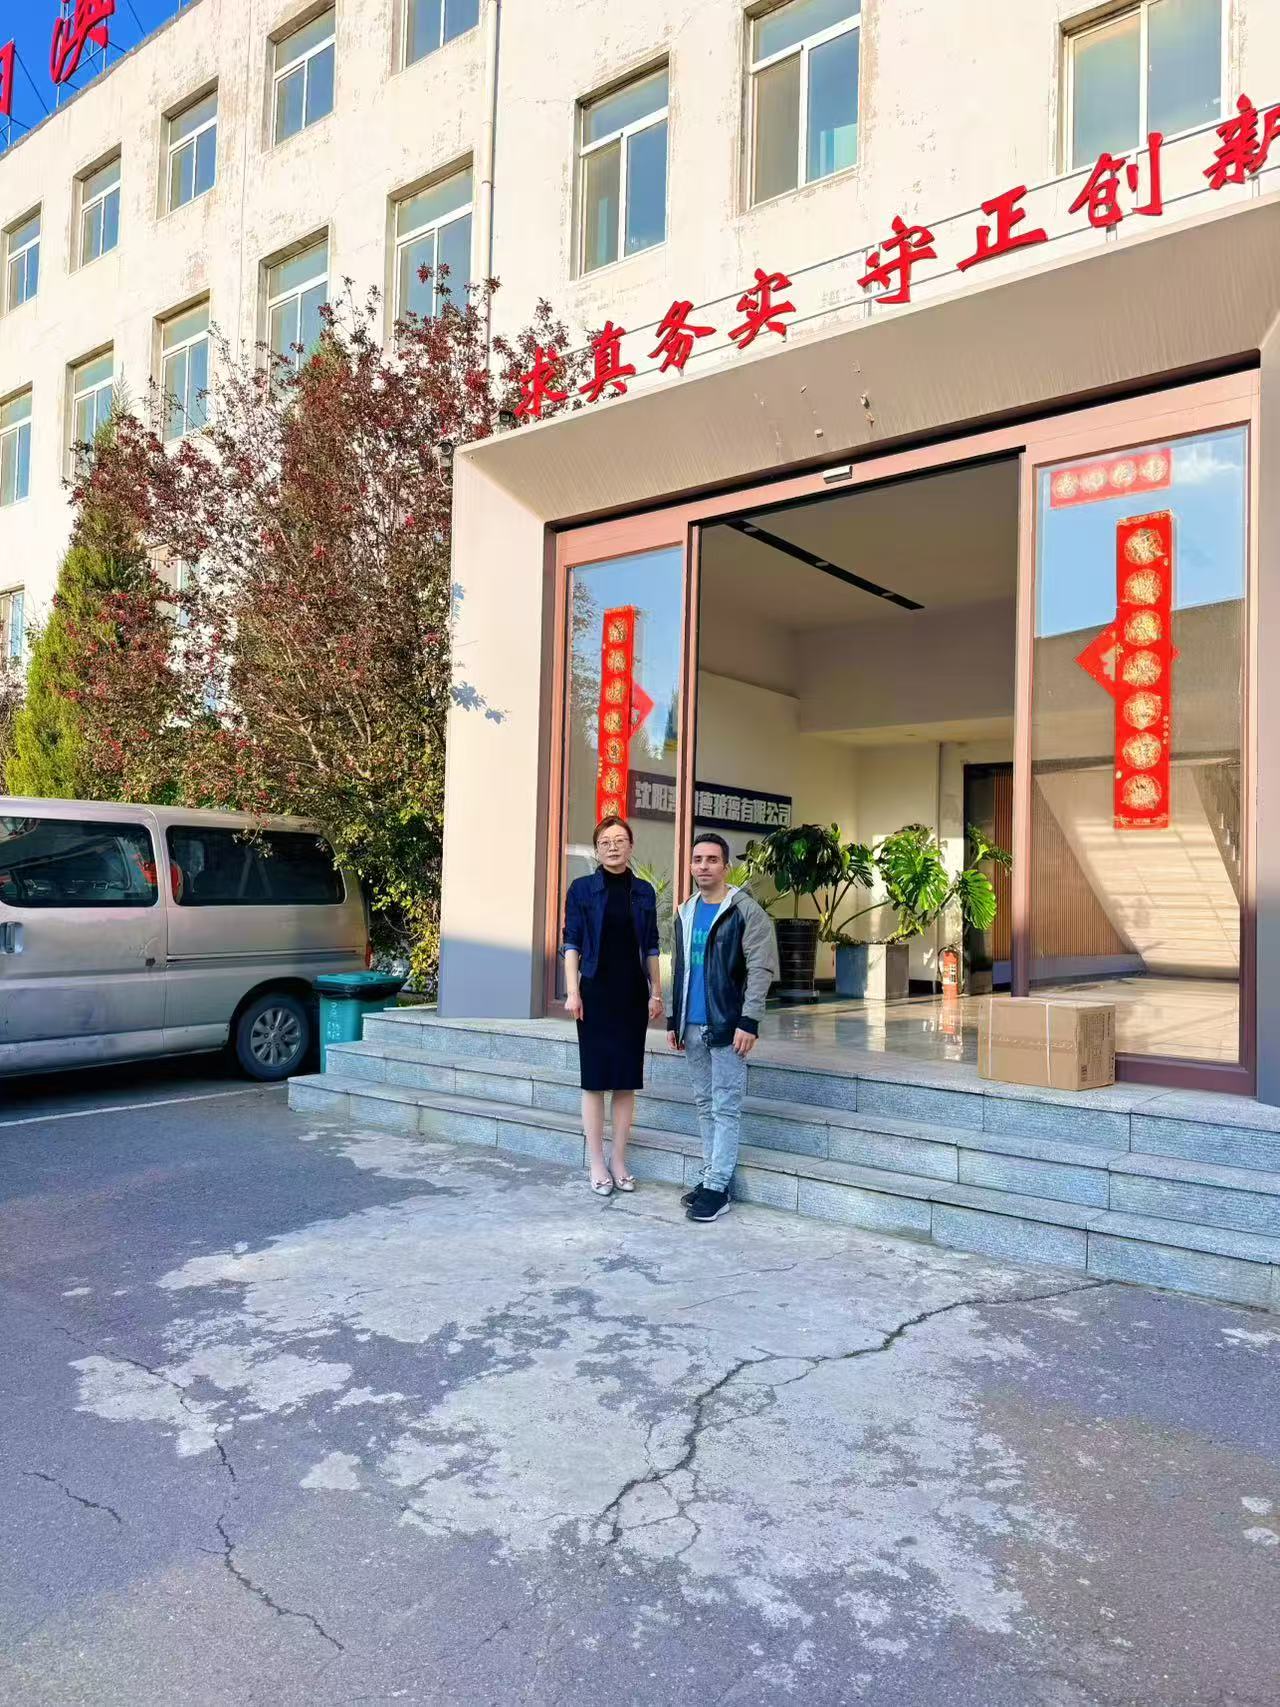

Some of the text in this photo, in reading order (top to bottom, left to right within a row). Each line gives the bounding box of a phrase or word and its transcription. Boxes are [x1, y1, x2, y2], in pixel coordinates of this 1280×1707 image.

[513, 94, 1280, 417] 求真务实 守正创新
